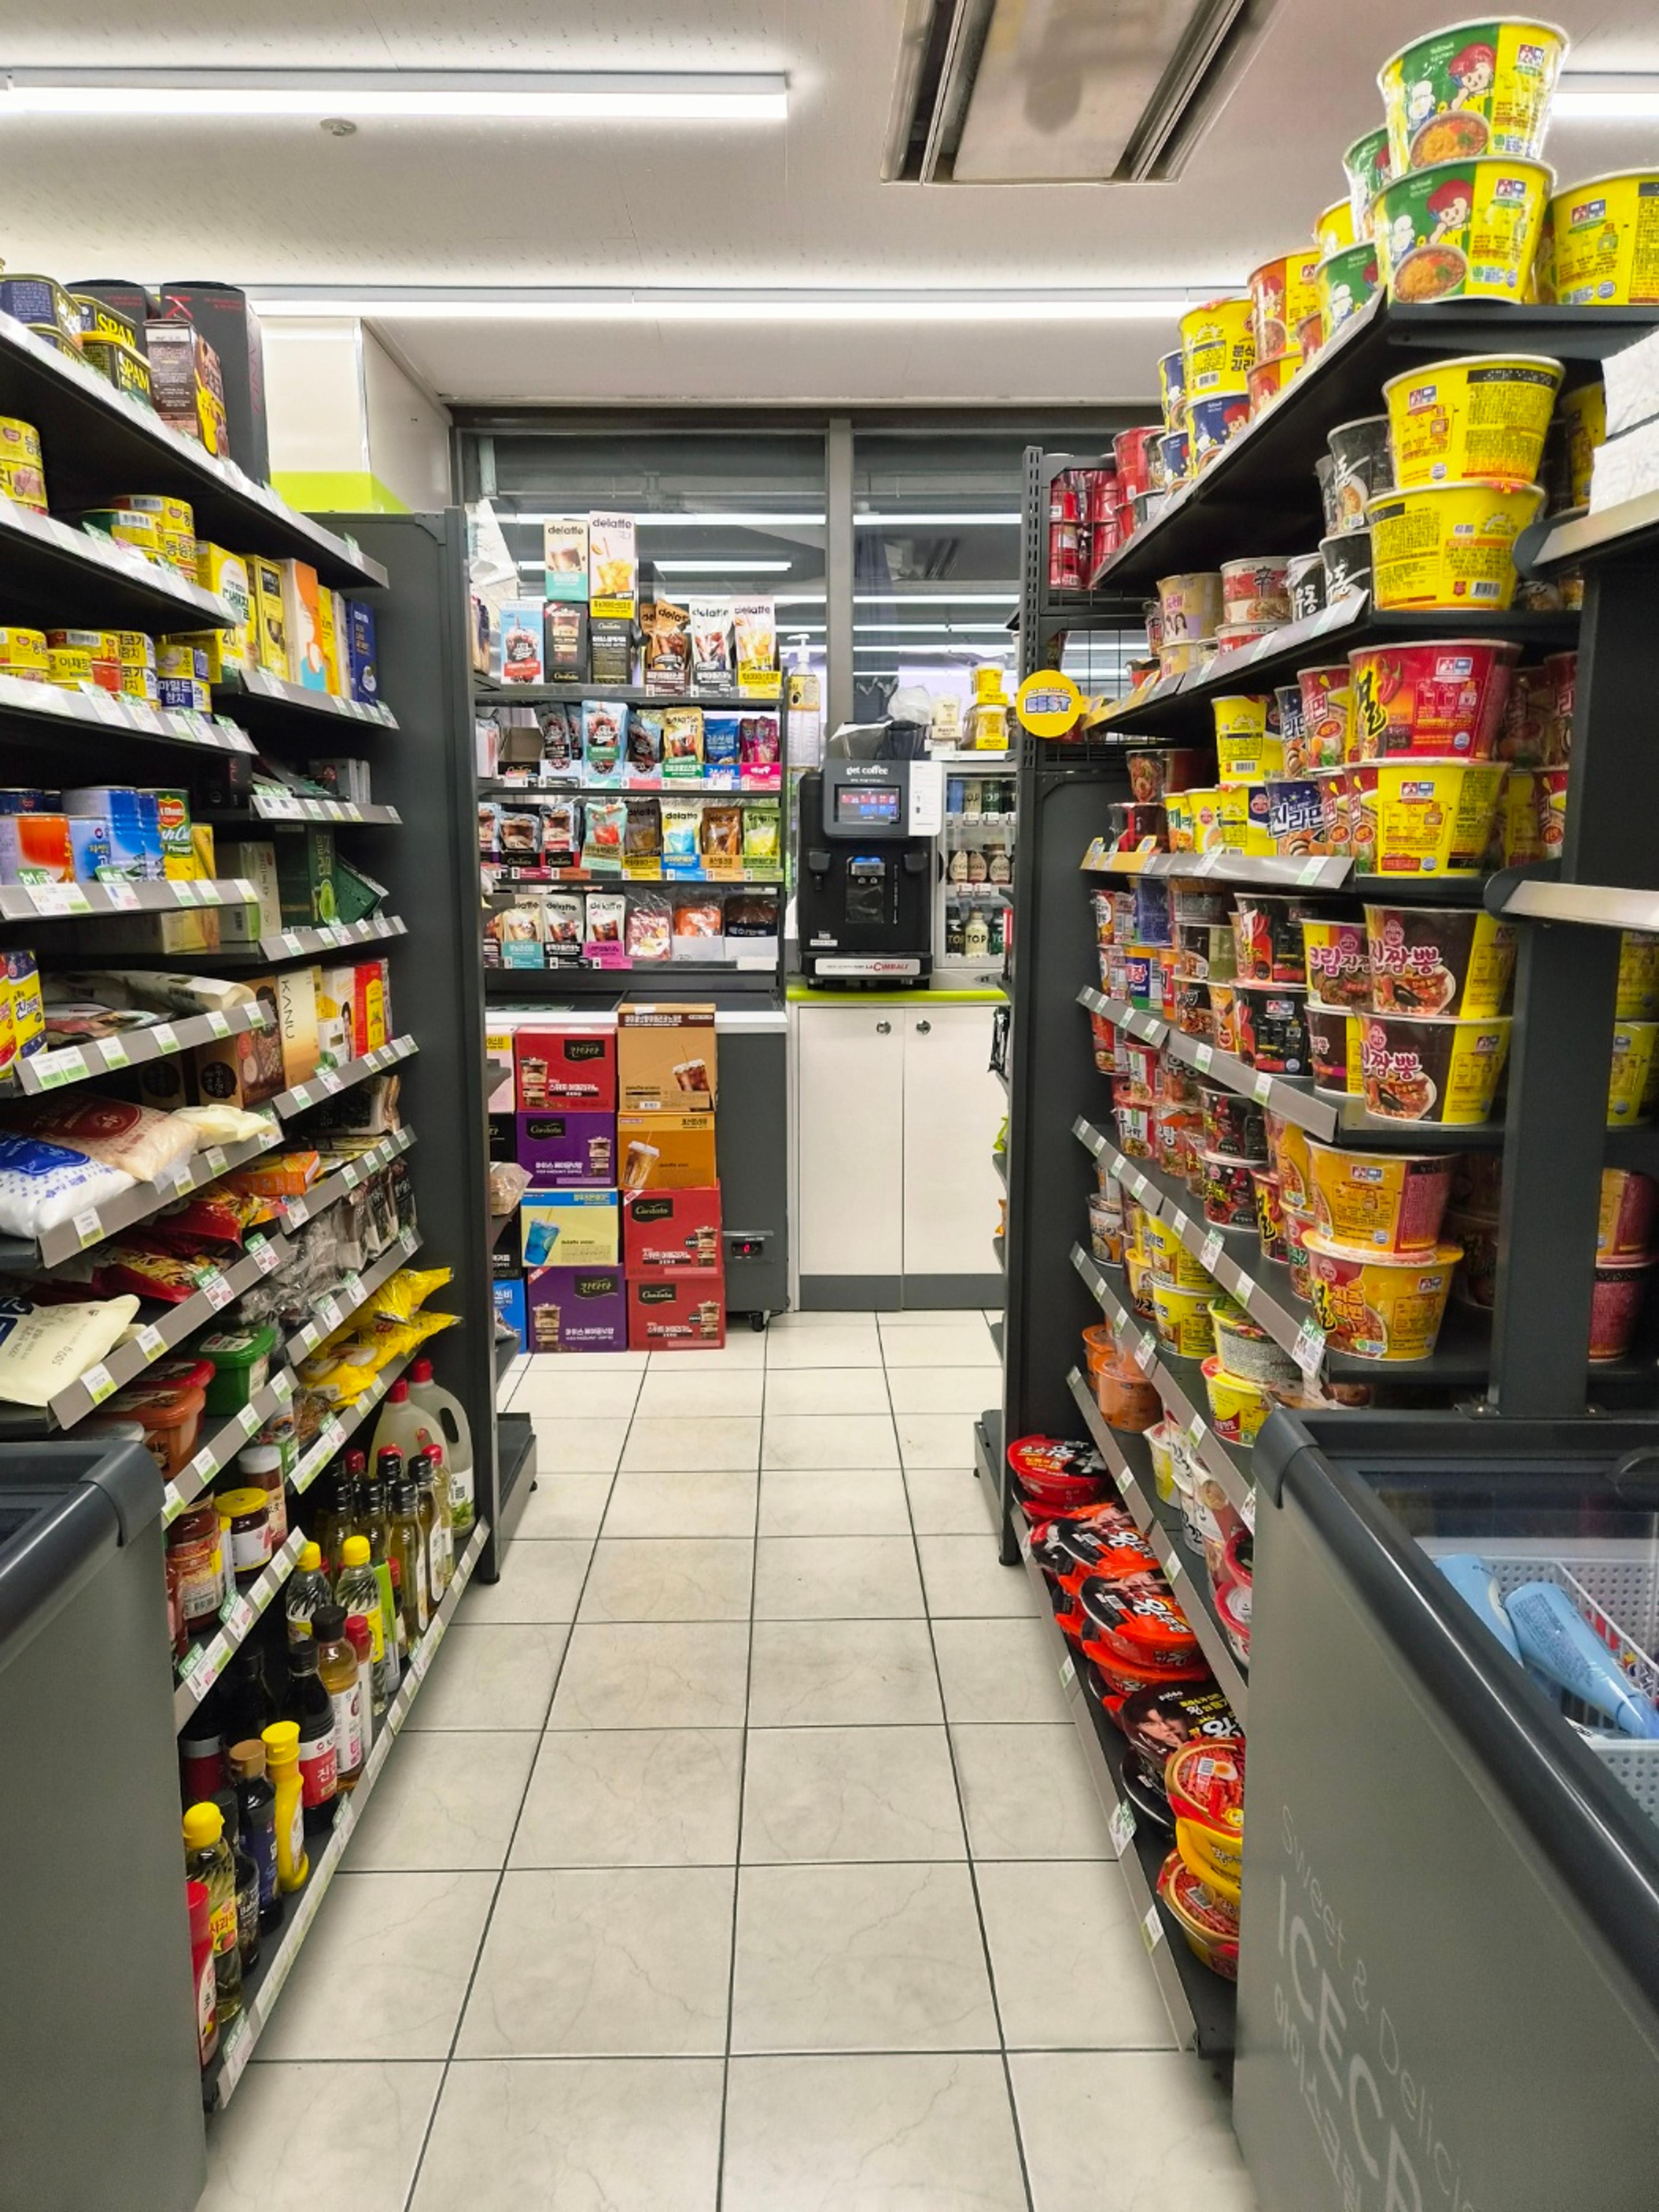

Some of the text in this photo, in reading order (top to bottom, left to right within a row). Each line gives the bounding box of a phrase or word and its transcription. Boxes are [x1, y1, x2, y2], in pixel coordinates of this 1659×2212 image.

[119, 356, 150, 394] SPAM
[548, 526, 584, 535] delatte
[592, 518, 632, 529] delatte
[1254, 566, 1276, 598] 辛
[1296, 585, 1318, 613] 우동
[734, 605, 770, 614] delatte
[1026, 695, 1071, 713] BEST
[846, 765, 889, 775] get coffee
[1268, 802, 1325, 838] 진라면
[967, 934, 986, 944] TOP
[281, 979, 295, 1039] KANU
